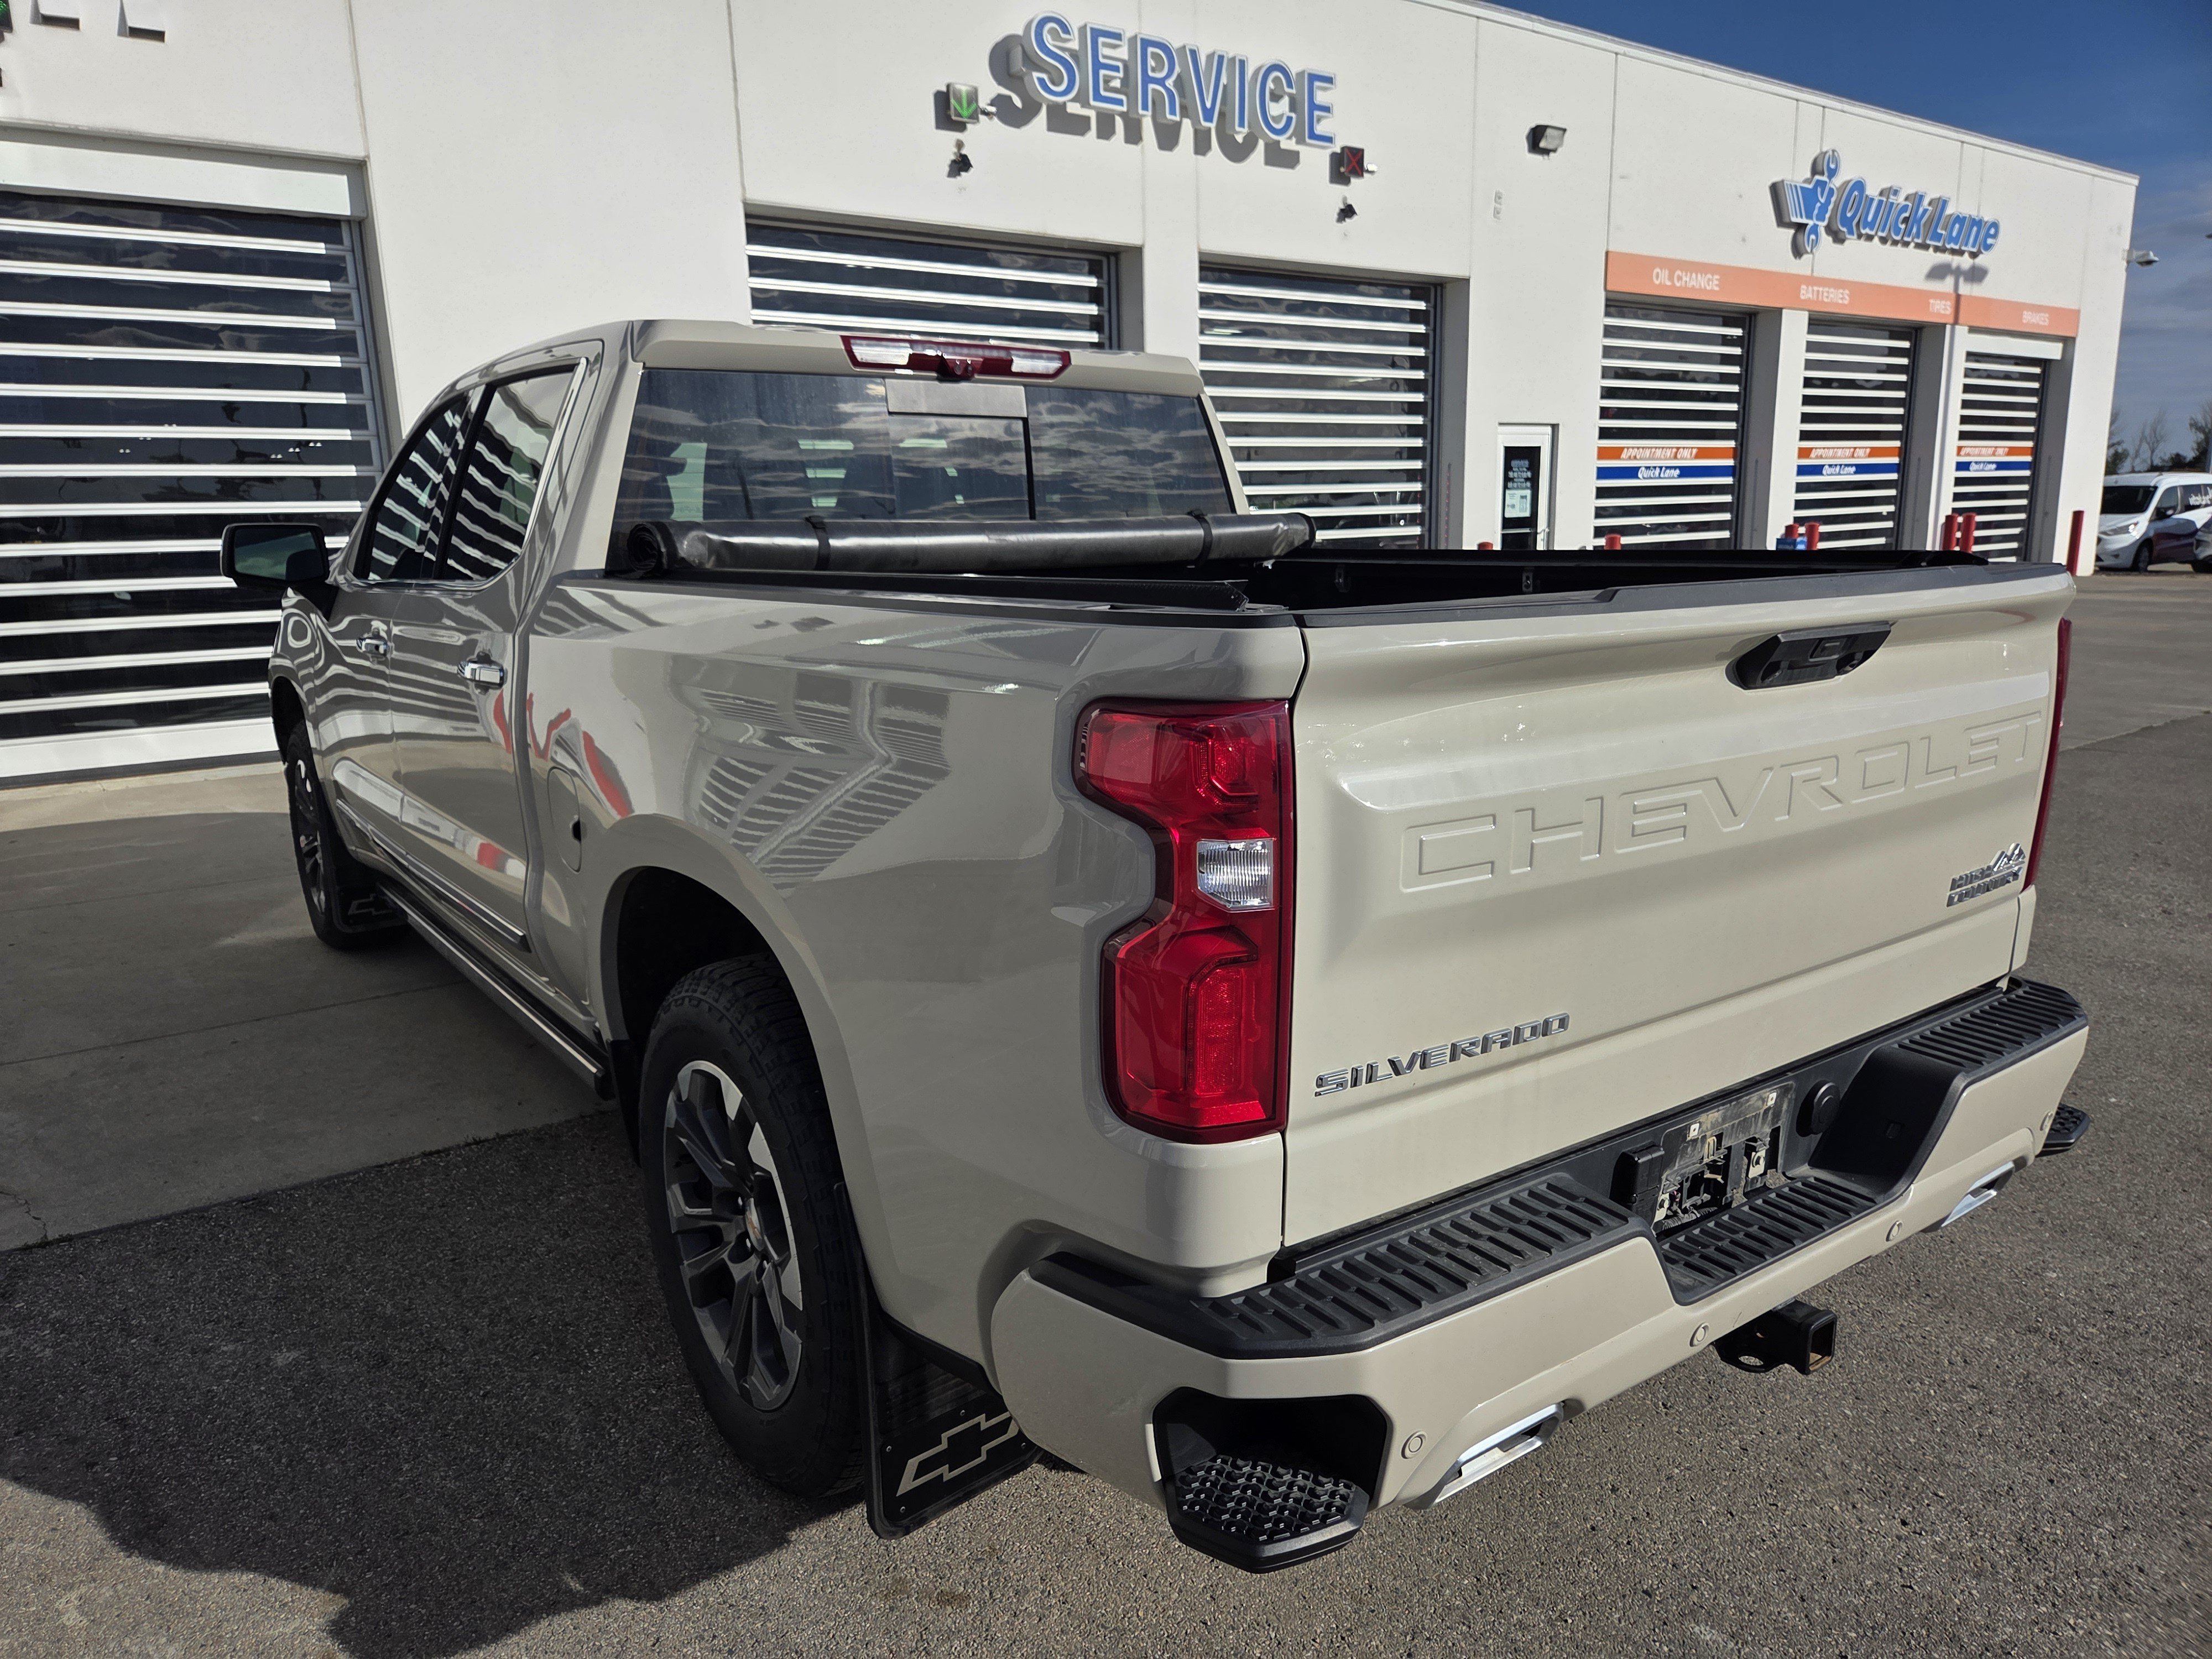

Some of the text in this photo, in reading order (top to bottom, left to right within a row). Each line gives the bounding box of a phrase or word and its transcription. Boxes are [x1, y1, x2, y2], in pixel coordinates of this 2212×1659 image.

[1023, 12, 1335, 147] SERVICE
[1837, 176, 2000, 254] Quick Lane
[1652, 267, 1720, 290] OIL CHANGE
[1799, 285, 1850, 304] BATTERIES
[1929, 298, 1952, 315] TIRES
[1620, 447, 1698, 460] APPOINTMENT ONLY
[1637, 466, 1681, 480] Quick Lane
[1399, 710, 2043, 893] CHEVROLET
[1314, 1012, 1571, 1098] SILVERADO
